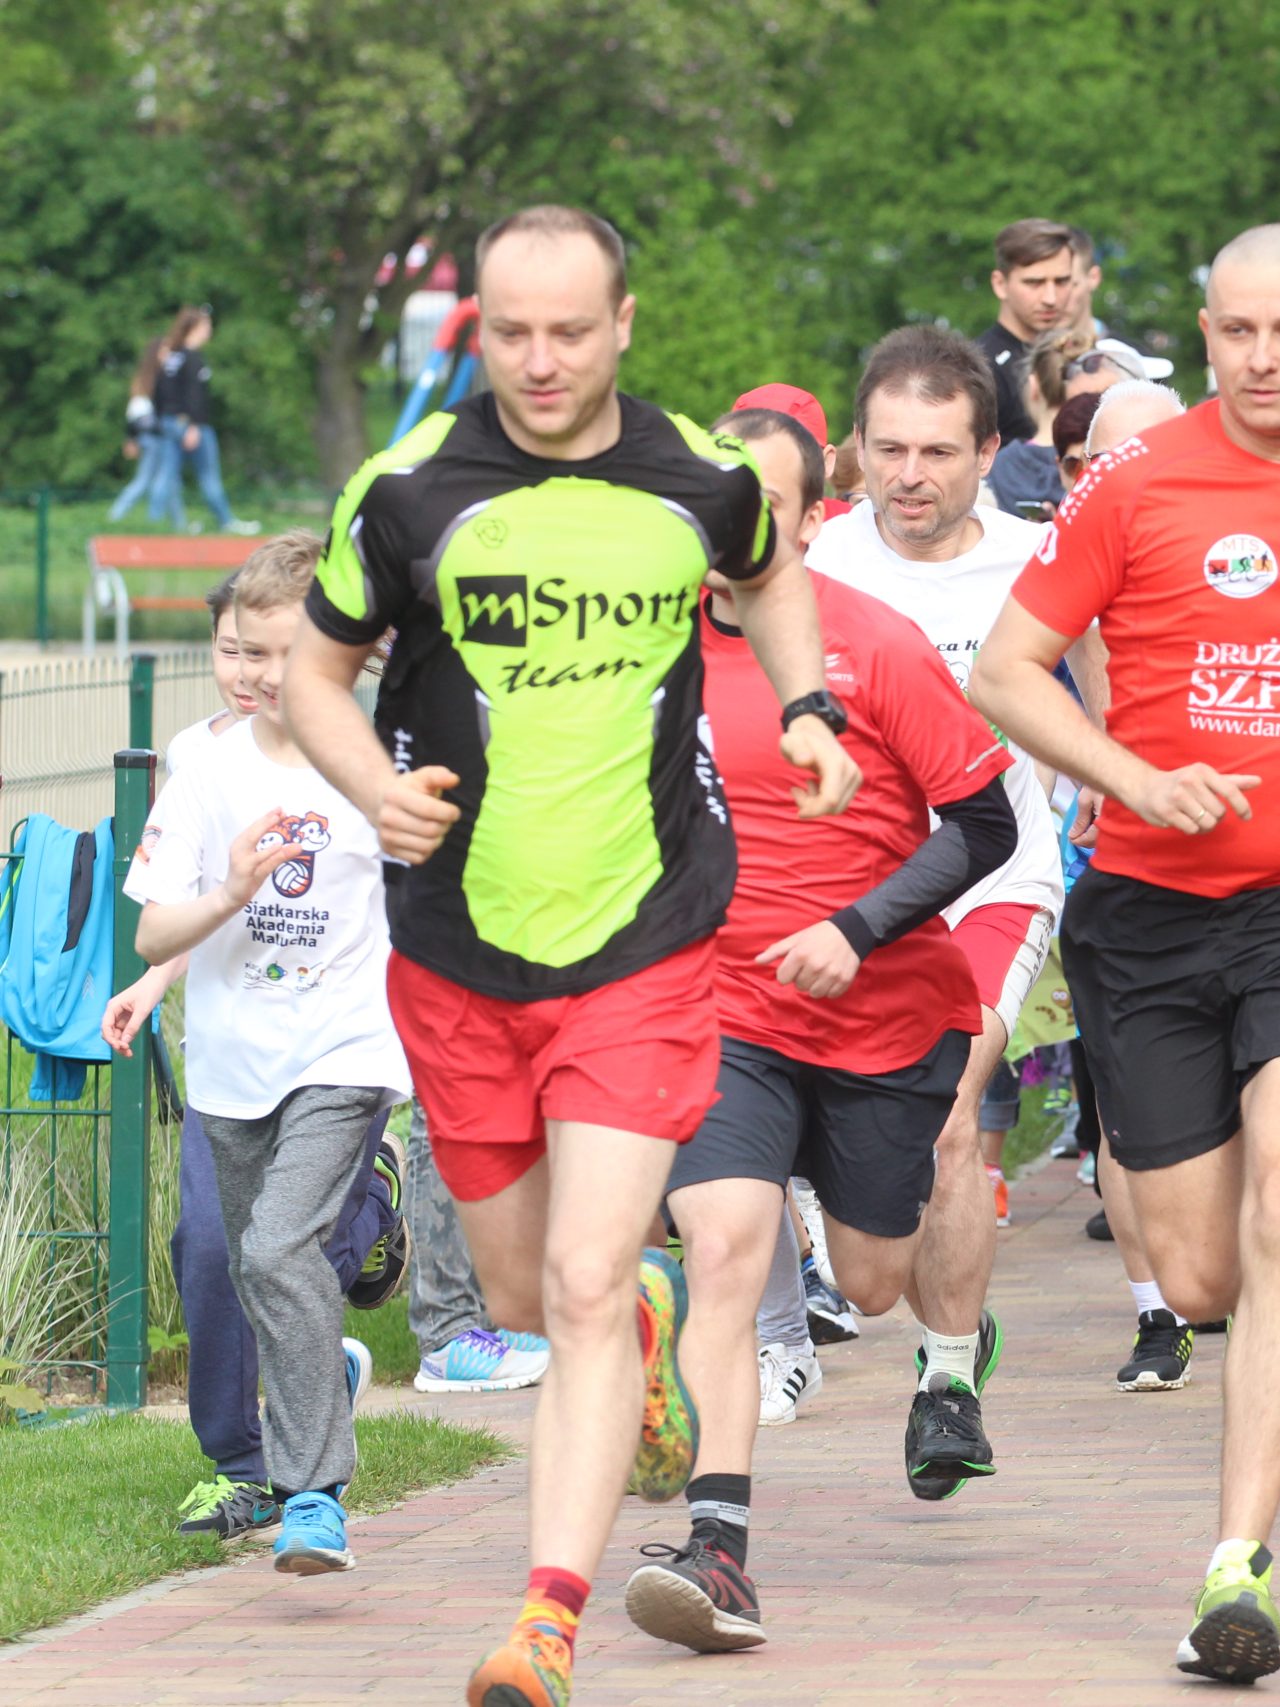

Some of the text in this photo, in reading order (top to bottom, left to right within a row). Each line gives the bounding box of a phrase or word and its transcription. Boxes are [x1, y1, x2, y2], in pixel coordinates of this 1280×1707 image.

[1222, 537, 1259, 552] MTS
[498, 658, 642, 694] team
[245, 901, 330, 920] Siatkarska
[246, 916, 325, 935] Akademia
[252, 930, 317, 948] Malucha
[936, 1343, 970, 1351] adidas
